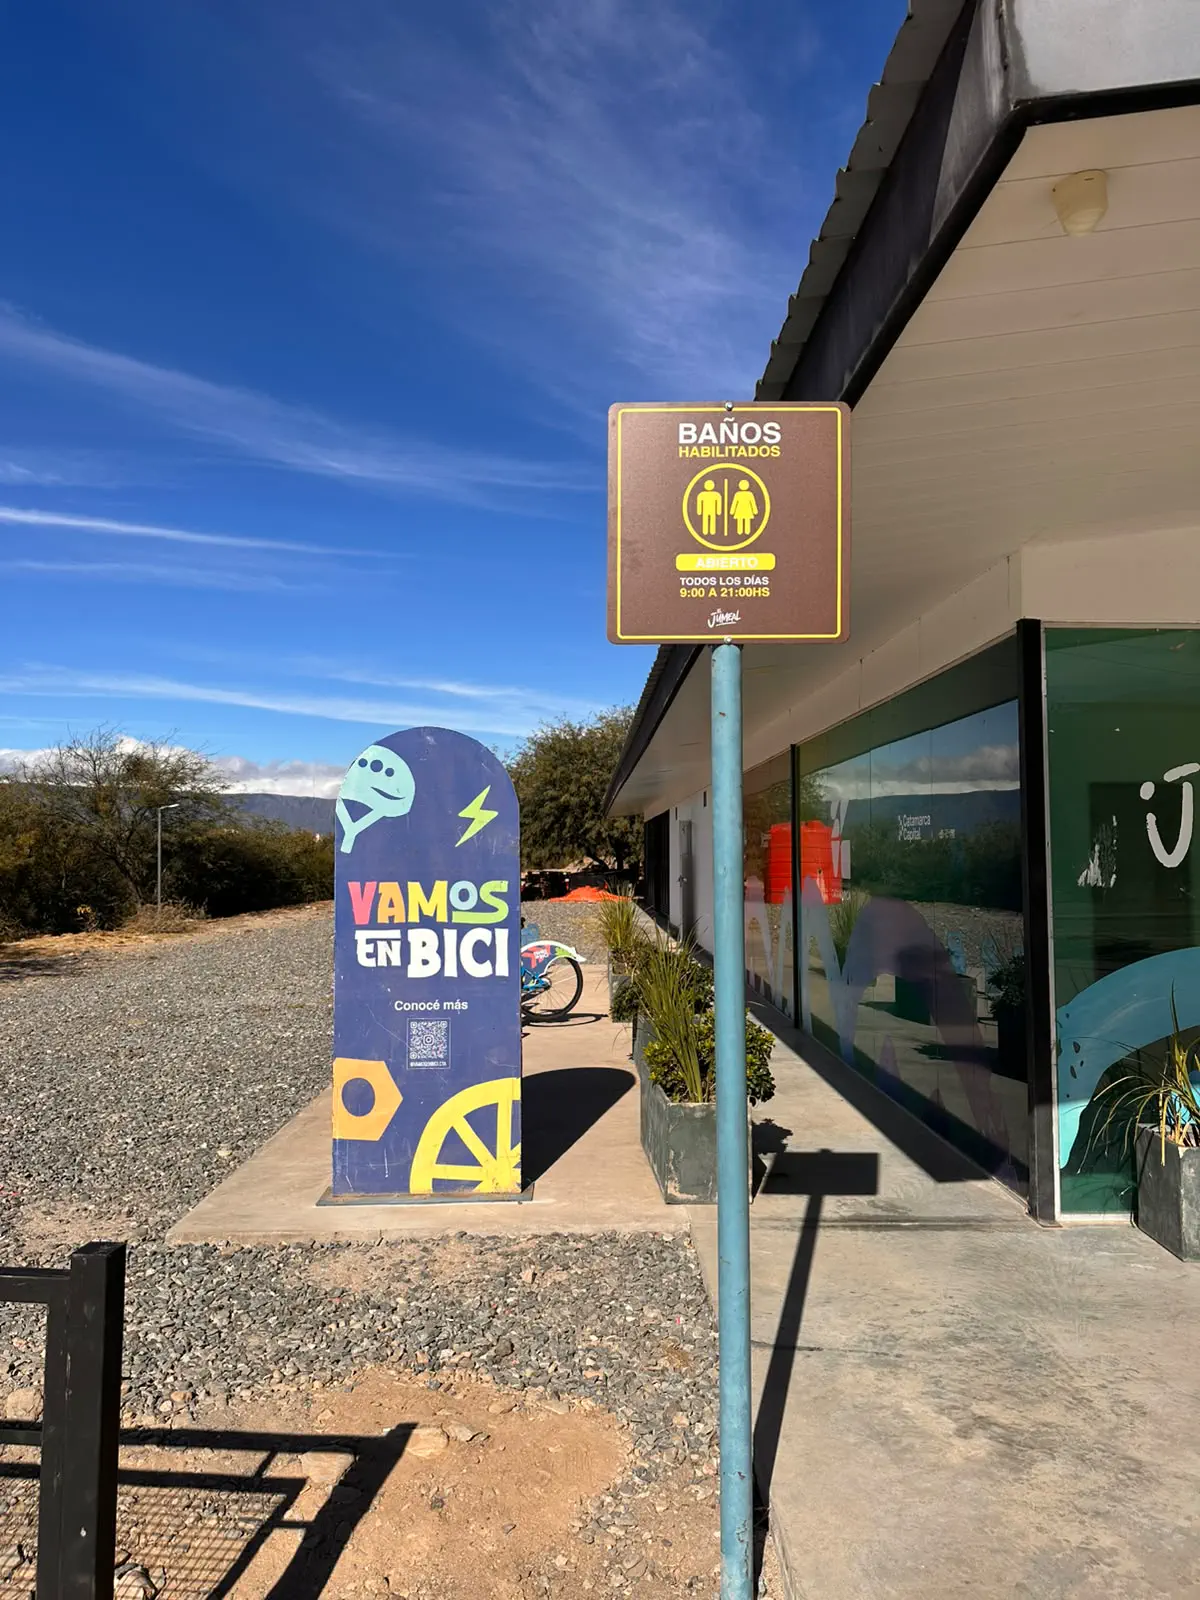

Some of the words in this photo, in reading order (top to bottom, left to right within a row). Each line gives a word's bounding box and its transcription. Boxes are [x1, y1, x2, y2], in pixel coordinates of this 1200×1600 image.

[679, 417, 782, 444] BAÑOS
[679, 445, 781, 458] HABILITADOS
[696, 557, 759, 569] ABIERTO
[680, 577, 717, 586] TODOS
[719, 577, 742, 586] LOS
[743, 574, 770, 586] DÍAS
[680, 587, 705, 598] 9:00
[708, 587, 718, 597] A
[720, 587, 770, 598] 21:00HS
[348, 880, 509, 925] VAMOS
[355, 929, 402, 967] EN
[407, 927, 509, 978] BICI
[394, 1000, 440, 1011] Conocé
[443, 999, 469, 1010] más
